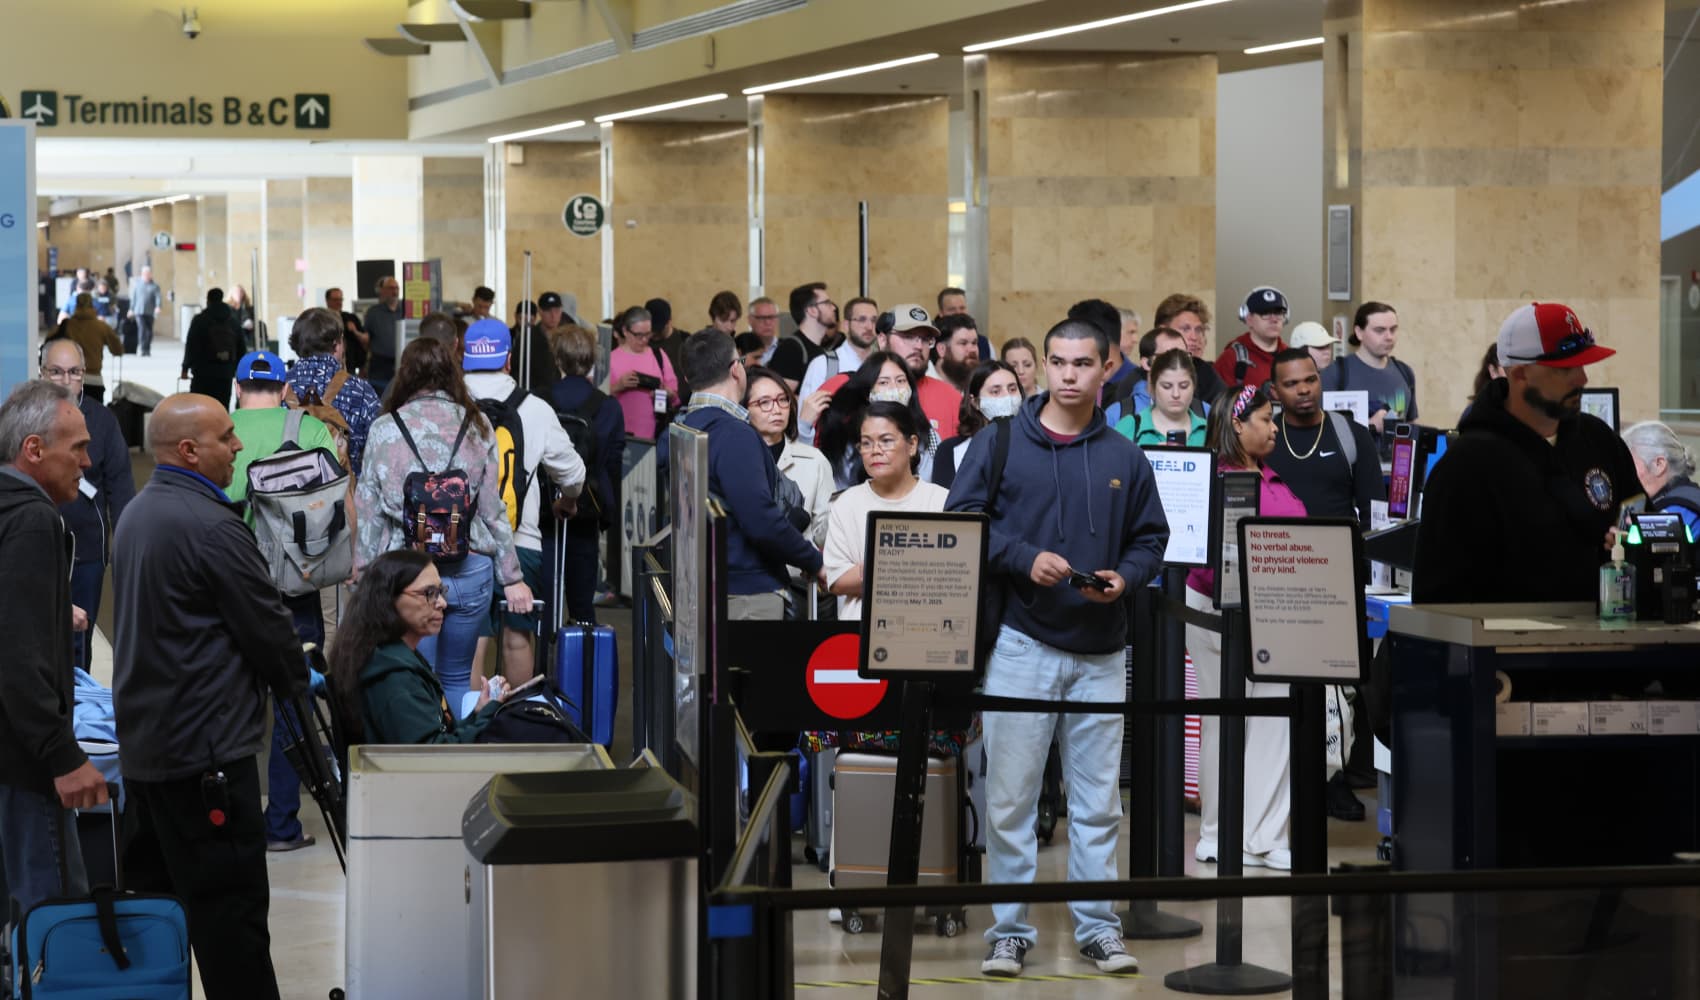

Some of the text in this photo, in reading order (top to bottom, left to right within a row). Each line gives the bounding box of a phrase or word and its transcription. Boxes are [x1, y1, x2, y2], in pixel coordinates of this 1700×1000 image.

[65, 95, 288, 125] Terminals B & C
[1183, 461, 1196, 472] ID
[1250, 531, 1291, 539] No threats.
[880, 532, 957, 548] REAL ID
[1289, 544, 1314, 552] abuse.
[878, 549, 904, 557] READY?
[1252, 556, 1329, 565] No physical violence
[1262, 567, 1276, 575] any
[1277, 566, 1297, 574] kind.
